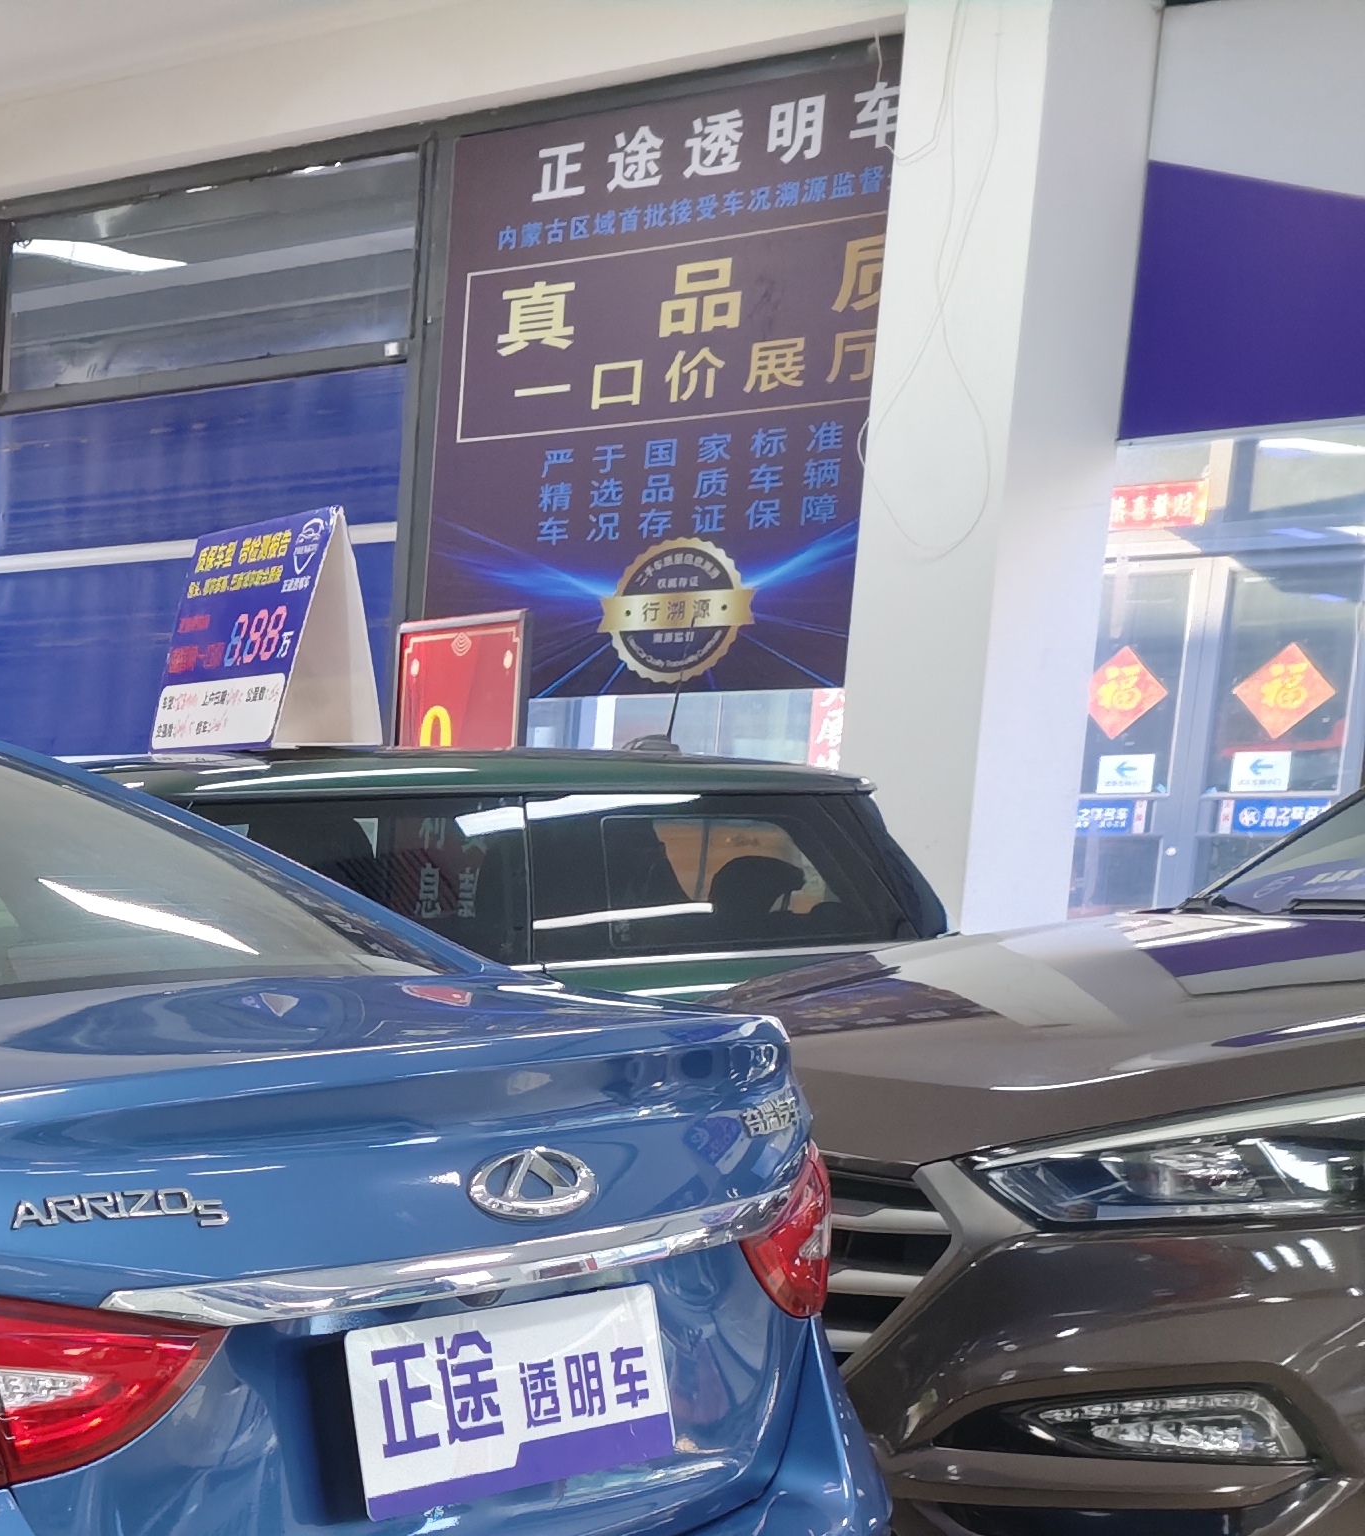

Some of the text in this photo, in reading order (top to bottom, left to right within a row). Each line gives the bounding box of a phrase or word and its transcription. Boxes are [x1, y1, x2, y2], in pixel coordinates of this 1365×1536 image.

[532, 81, 900, 203] 正途透明车
[497, 165, 893, 251] 内蒙古区域首批接受车况溯源监督
[514, 330, 876, 409] 一口价展厅
[541, 421, 843, 478] 严于国家标准
[539, 458, 840, 512] 精选品质车辆
[537, 494, 839, 546] 车况存证保障
[1097, 664, 1142, 710] 福
[1261, 662, 1308, 710] 福
[371, 1330, 650, 1458] 正途 透明车
